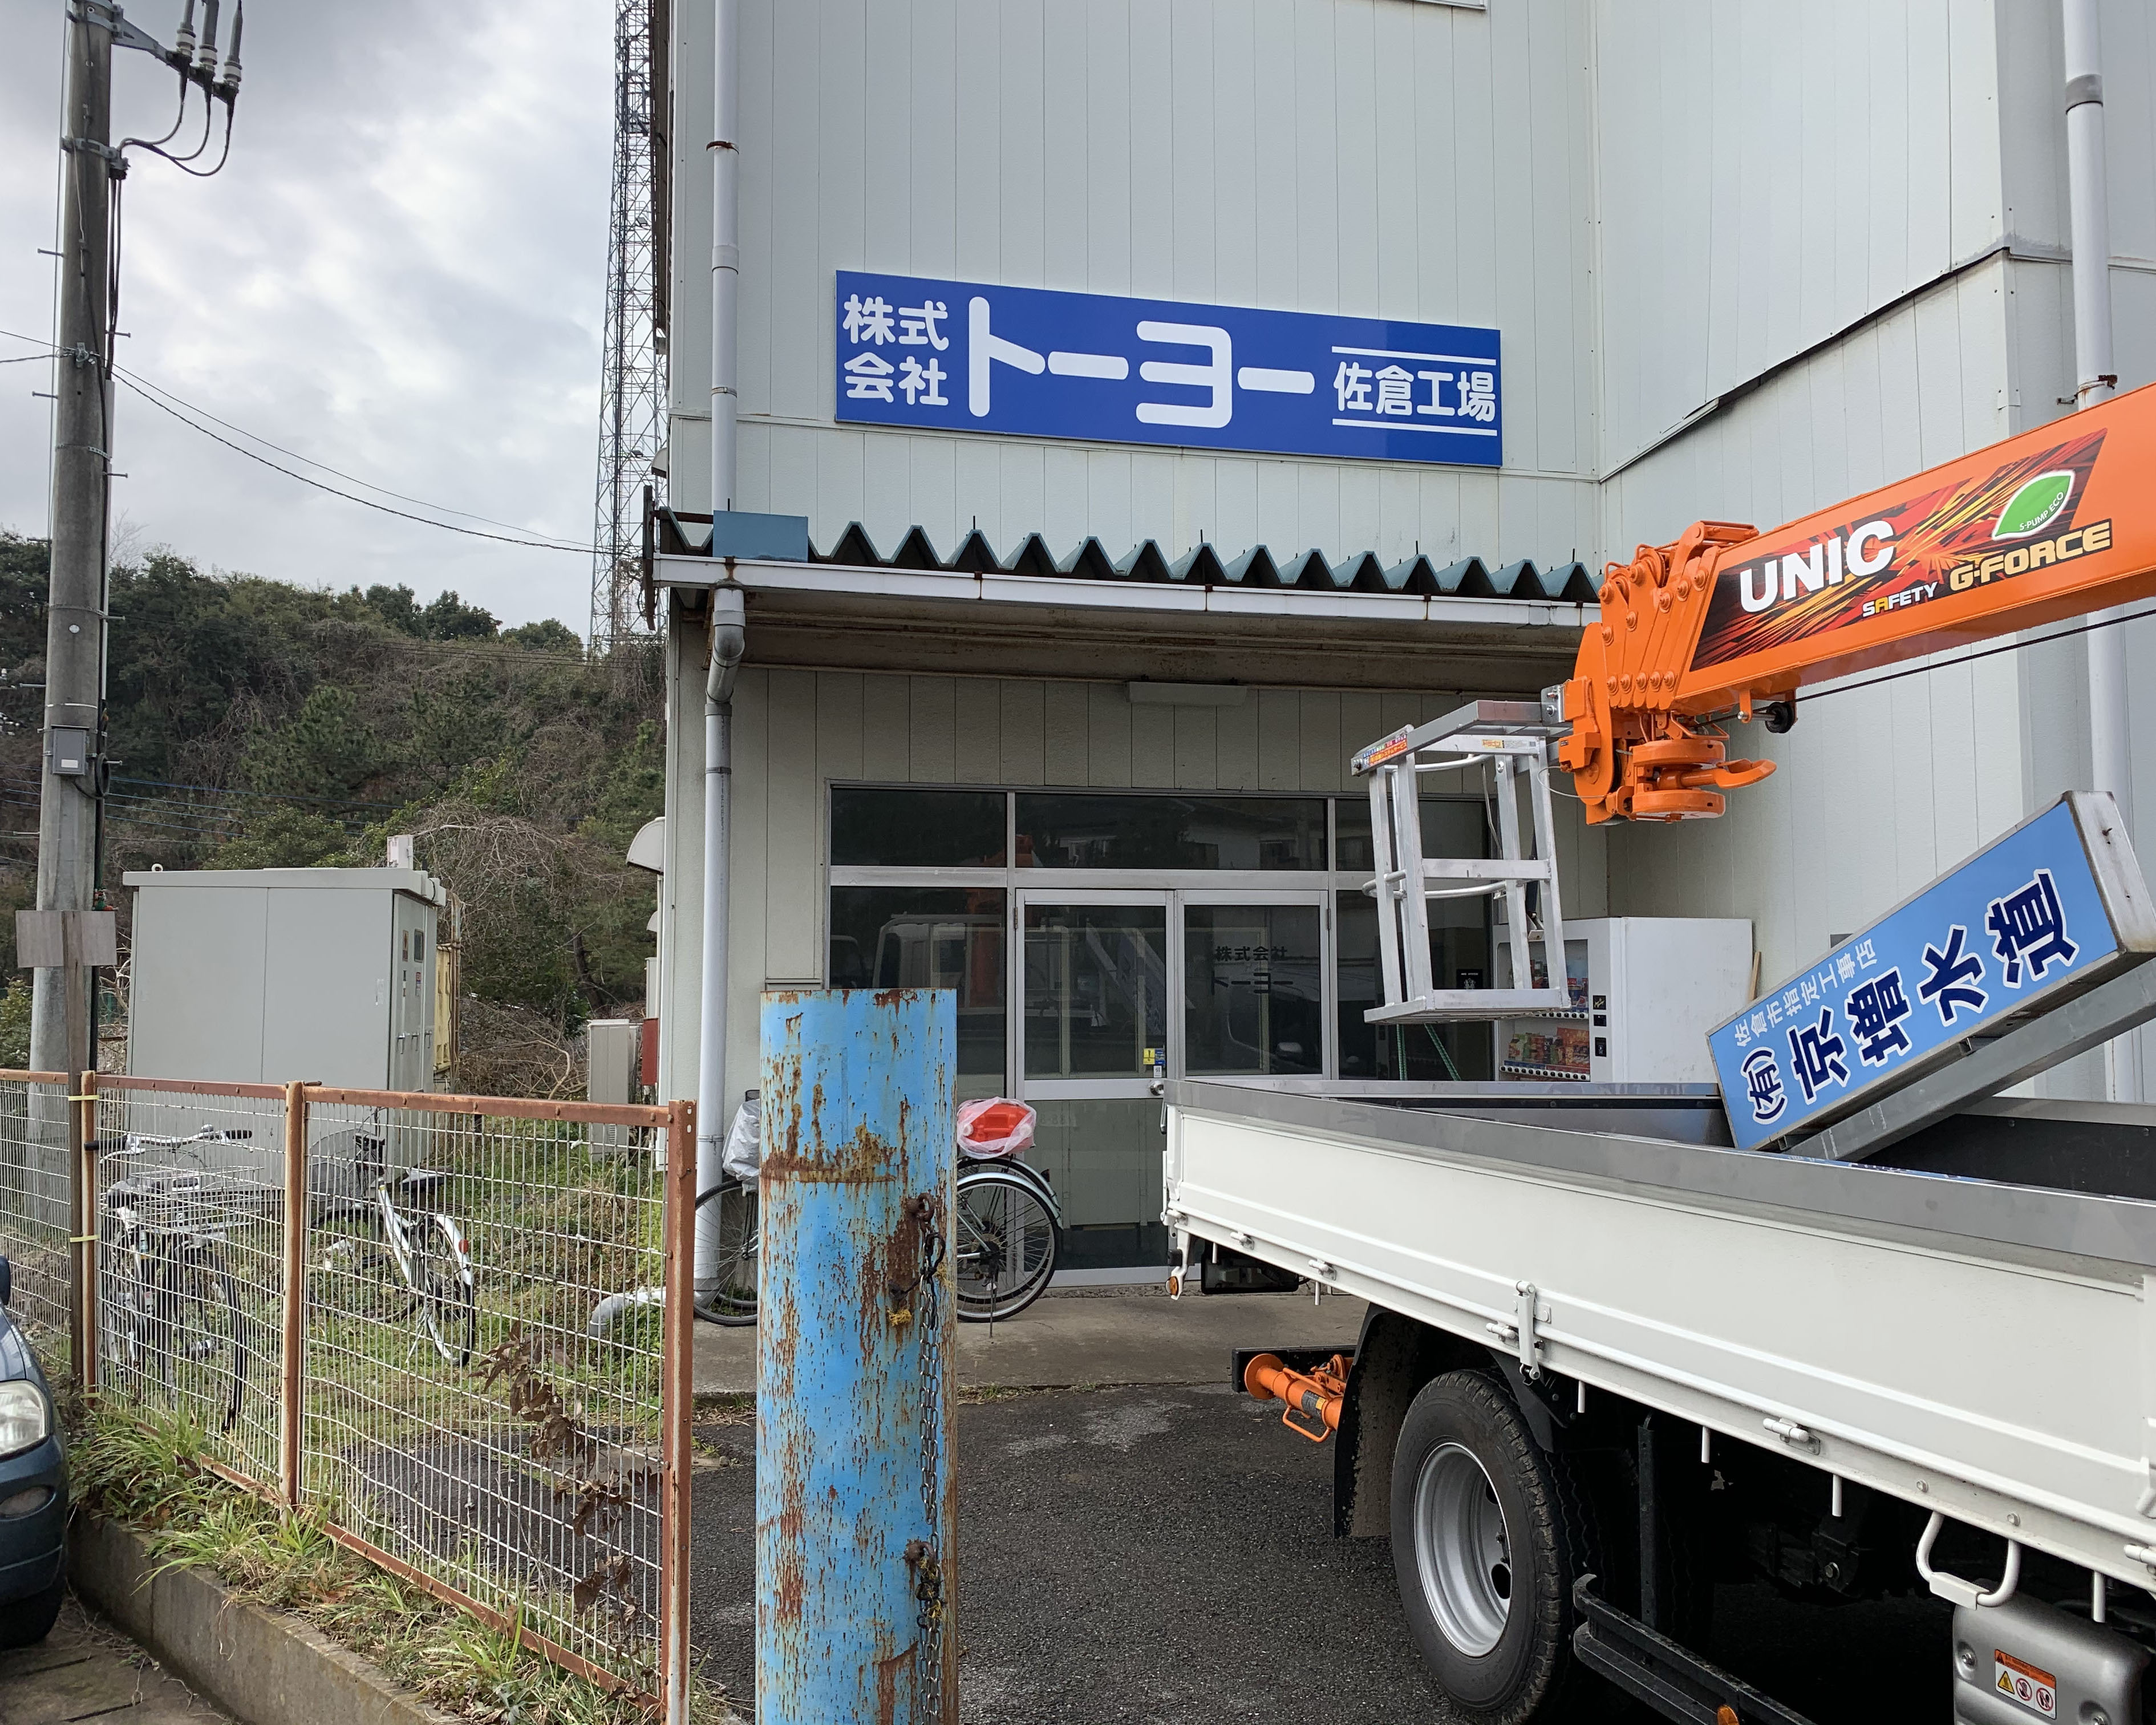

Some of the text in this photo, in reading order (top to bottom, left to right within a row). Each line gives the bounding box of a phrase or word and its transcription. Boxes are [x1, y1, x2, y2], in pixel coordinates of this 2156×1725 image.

[842, 294, 949, 351] 株式
[844, 352, 949, 406] 会社
[968, 296, 1315, 429] トーヨー
[1332, 361, 1496, 422] 佐倉工場
[2019, 491, 2064, 531] S-PUMP ECO
[1740, 520, 1895, 613] UNIC
[1862, 581, 1939, 618] SAFETY
[1215, 946, 1287, 962] 株式会社
[1211, 971, 1294, 995] トーヨー
[1734, 938, 1878, 1047] 佐倉市指定工事店
